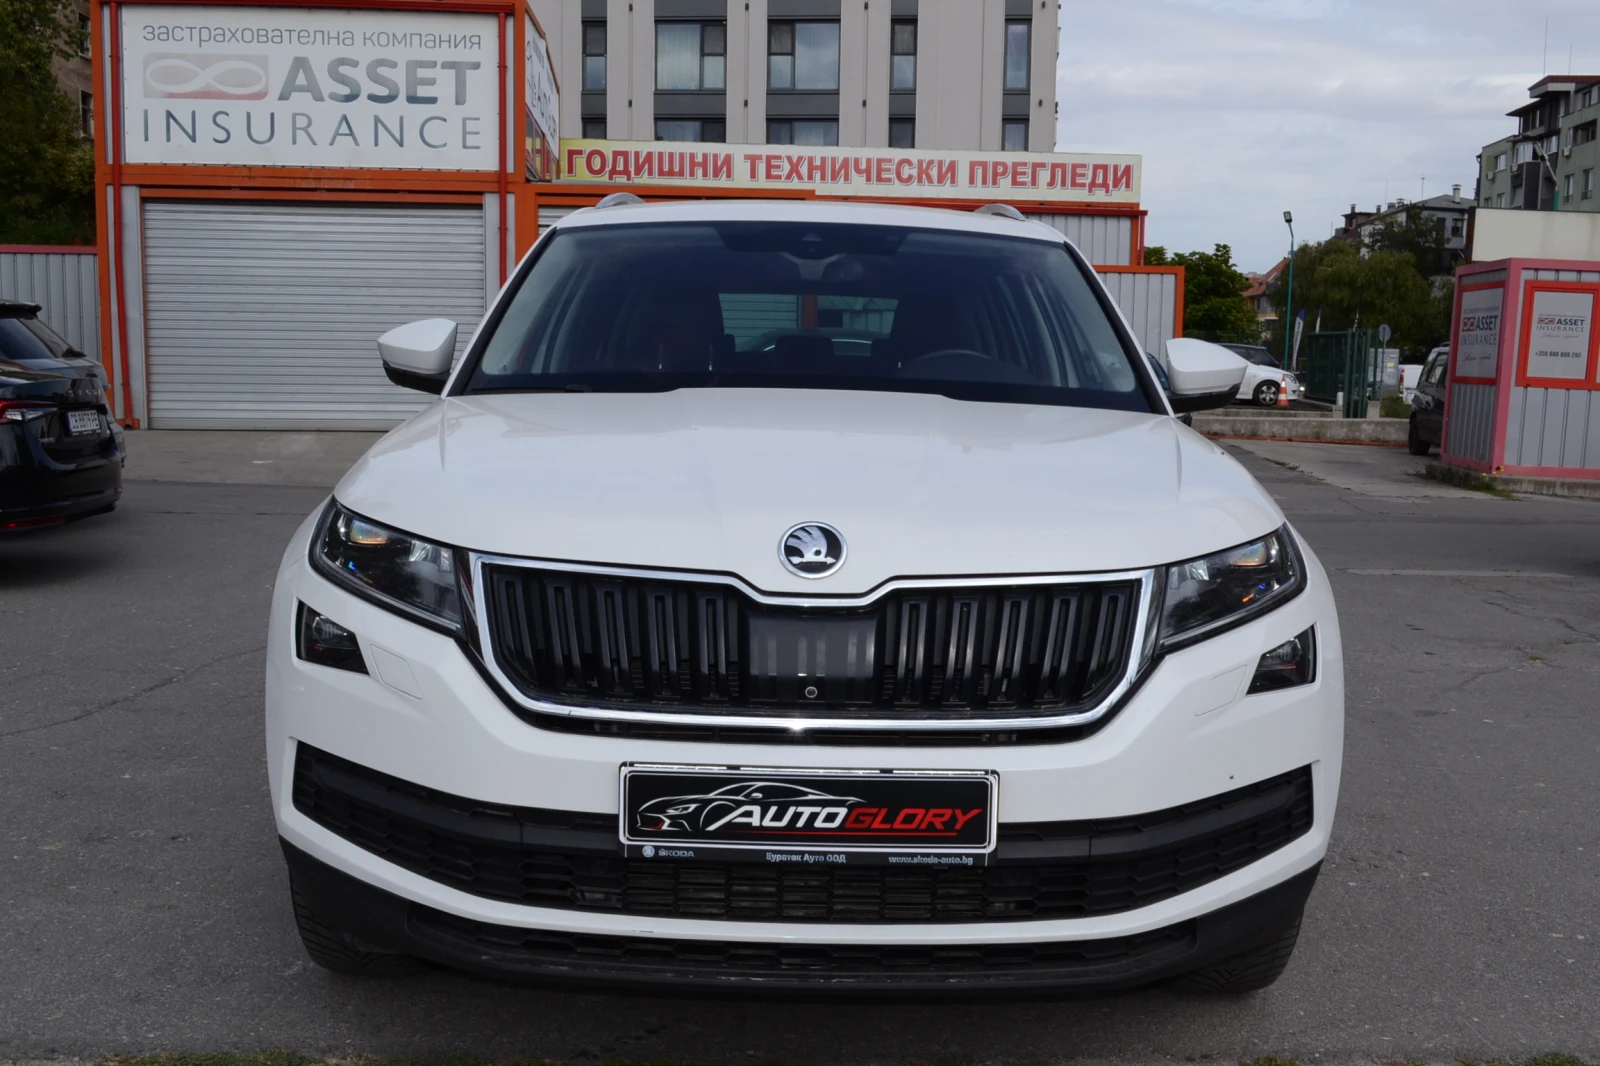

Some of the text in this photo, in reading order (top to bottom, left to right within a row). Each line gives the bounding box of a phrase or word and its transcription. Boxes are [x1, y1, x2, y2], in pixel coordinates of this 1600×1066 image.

[143, 25, 481, 49] застрахователна компания
[277, 56, 481, 105] ASSET
[143, 109, 481, 149] INSURANCE
[566, 148, 733, 183] ГОДИШНИ
[743, 154, 958, 187] ТЕХНИЧЕСКИ
[968, 160, 1133, 195] ПРЕГЛЕДИ
[1475, 315, 1499, 331] ASSET
[1536, 325, 1585, 333] INSURANCE
[1556, 318, 1585, 327] ASSET
